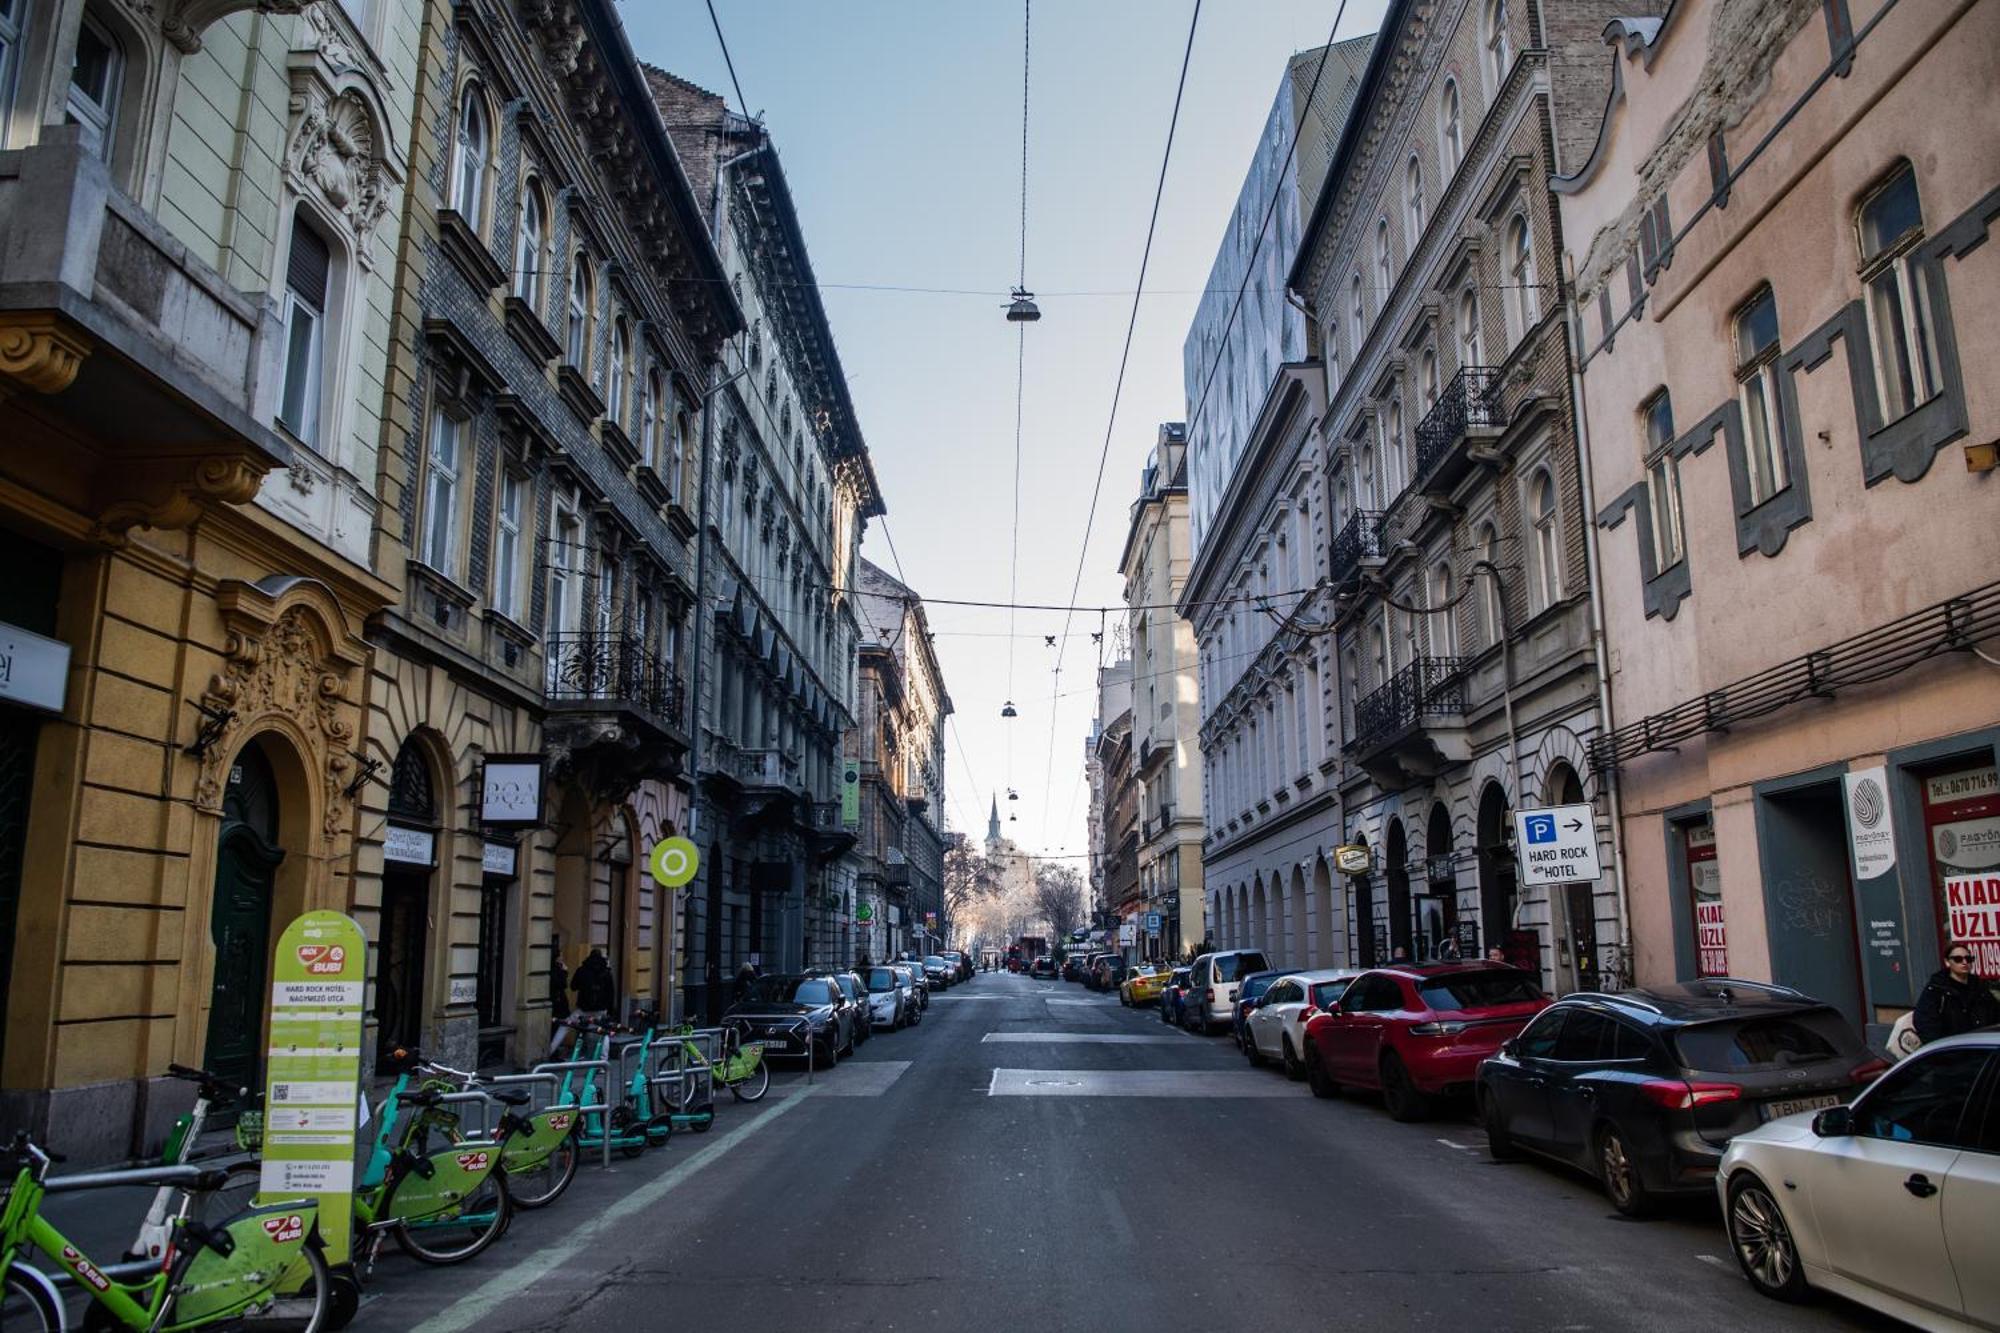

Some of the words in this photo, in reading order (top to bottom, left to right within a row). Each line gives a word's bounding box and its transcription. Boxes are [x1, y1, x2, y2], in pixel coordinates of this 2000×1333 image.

[1534, 824, 1548, 840] P
[1529, 850, 1557, 862] HARD
[1561, 847, 1588, 859] ROCK
[1545, 865, 1577, 878] HOTEL
